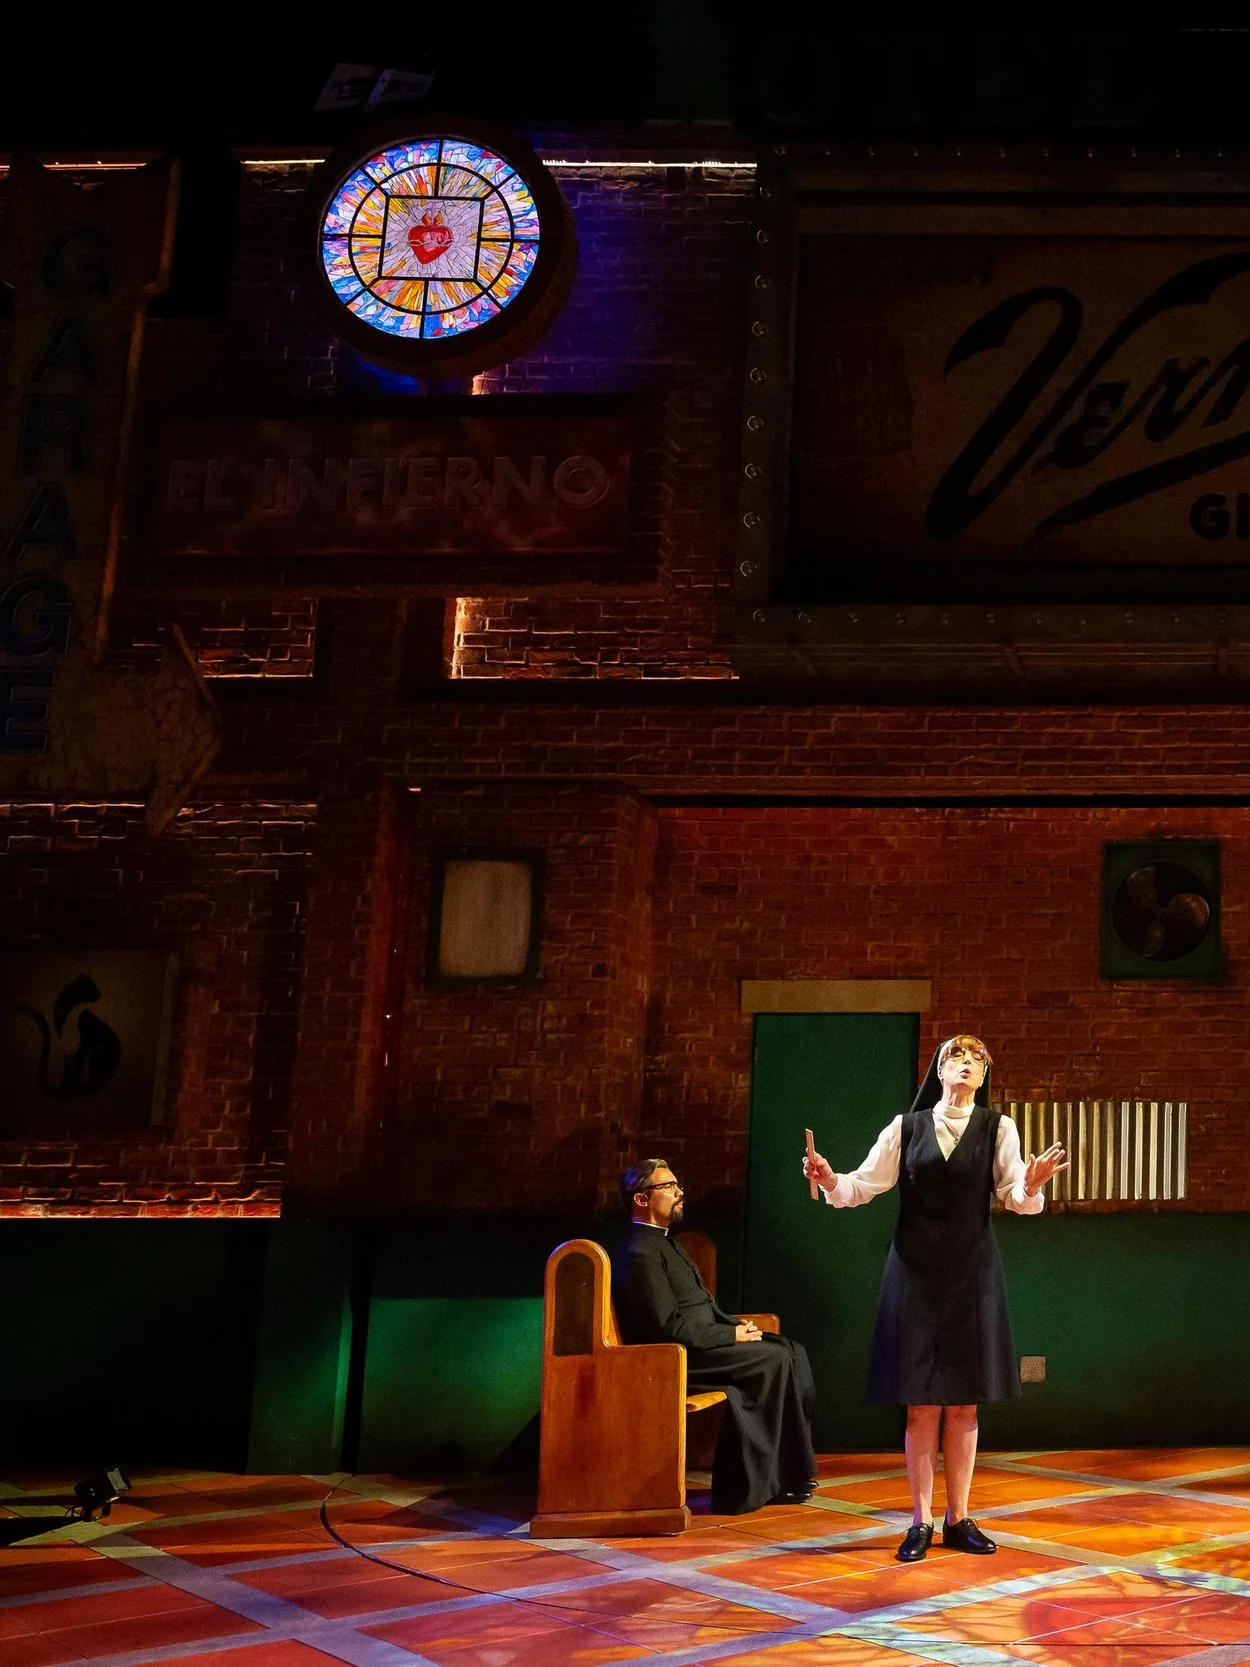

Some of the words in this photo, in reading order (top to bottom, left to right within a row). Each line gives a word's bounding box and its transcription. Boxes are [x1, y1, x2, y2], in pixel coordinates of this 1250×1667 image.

[0, 222, 116, 753] GARAGE
[167, 457, 237, 512] EL
[261, 454, 613, 511] INFIERNO
